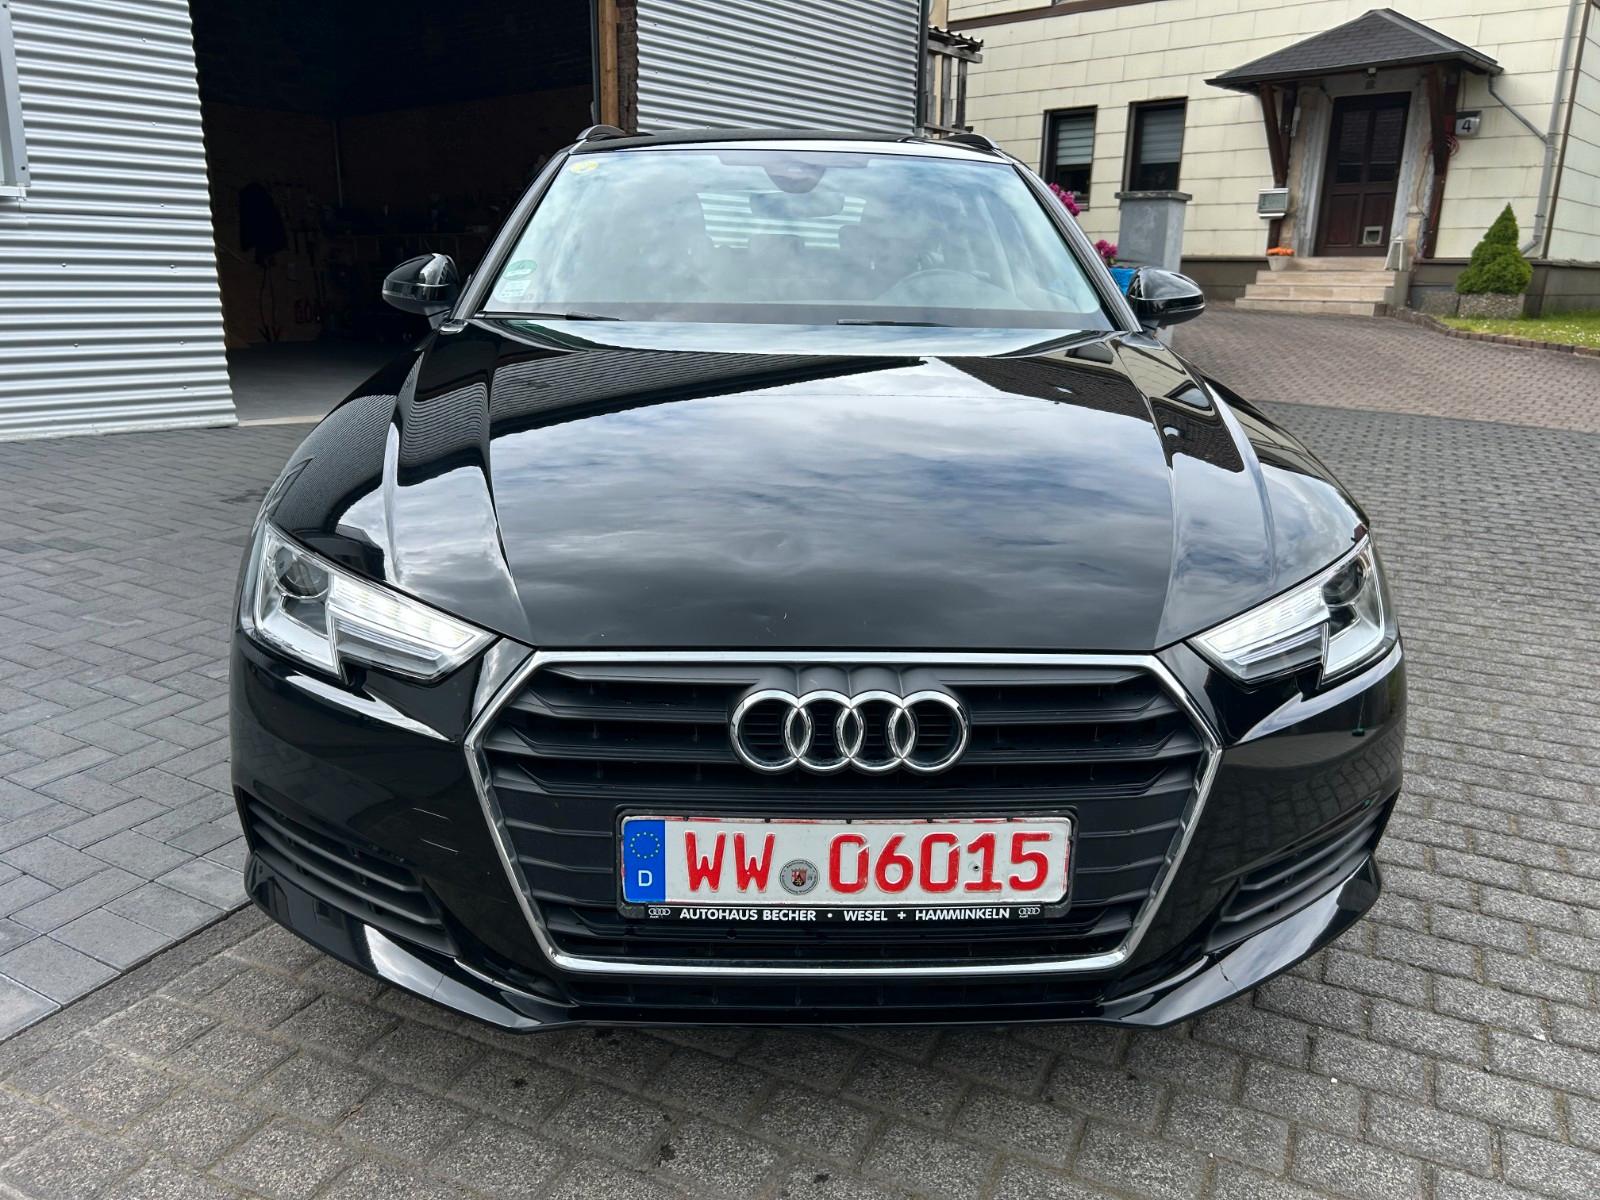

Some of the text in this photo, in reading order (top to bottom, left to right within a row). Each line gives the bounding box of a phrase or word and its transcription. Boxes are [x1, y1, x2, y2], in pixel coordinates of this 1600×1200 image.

[1461, 119, 1472, 133] 4
[684, 831, 777, 893] WW
[829, 832, 1054, 894] 06015
[638, 870, 653, 887] D
[680, 908, 758, 920] AUTOHAUS
[763, 910, 816, 921] BECHER
[843, 909, 888, 921] WESEL
[915, 908, 1011, 920] HAMMINKELN
